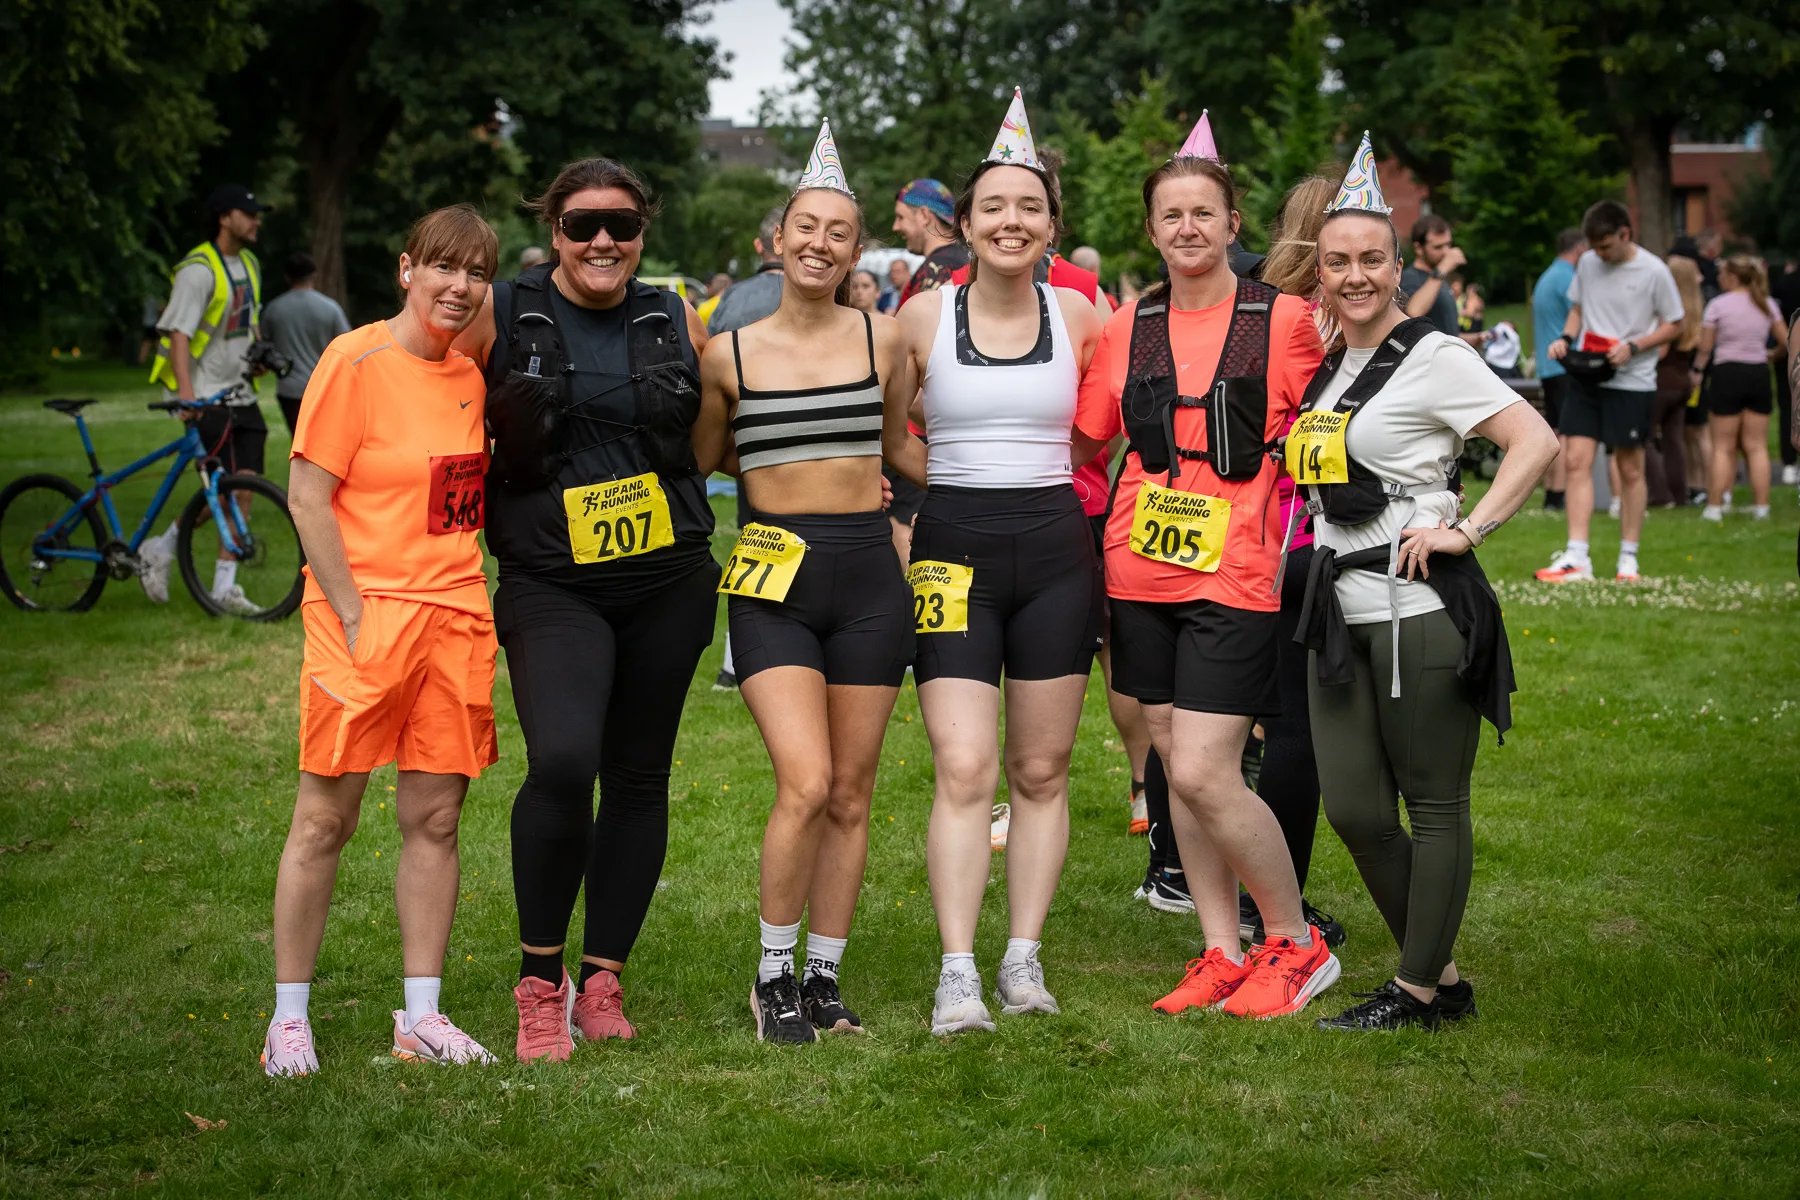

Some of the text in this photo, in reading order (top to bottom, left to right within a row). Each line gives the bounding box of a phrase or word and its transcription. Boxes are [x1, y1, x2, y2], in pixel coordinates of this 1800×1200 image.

[1317, 415, 1342, 425] AND
[1299, 444, 1322, 480] 14
[604, 480, 644, 499] UP AND
[600, 487, 650, 511] RUNNING
[1163, 495, 1207, 507] UP AND
[442, 490, 481, 529] 568
[615, 502, 640, 514] EVENTS
[1156, 503, 1211, 518] RUNNING
[1168, 515, 1193, 523] EVENTS
[593, 510, 653, 558] 207
[747, 528, 782, 541] UP AND
[1141, 520, 1202, 563] 205
[745, 547, 770, 557] EVENTS
[721, 554, 774, 595] 271
[913, 565, 947, 577] UP AND
